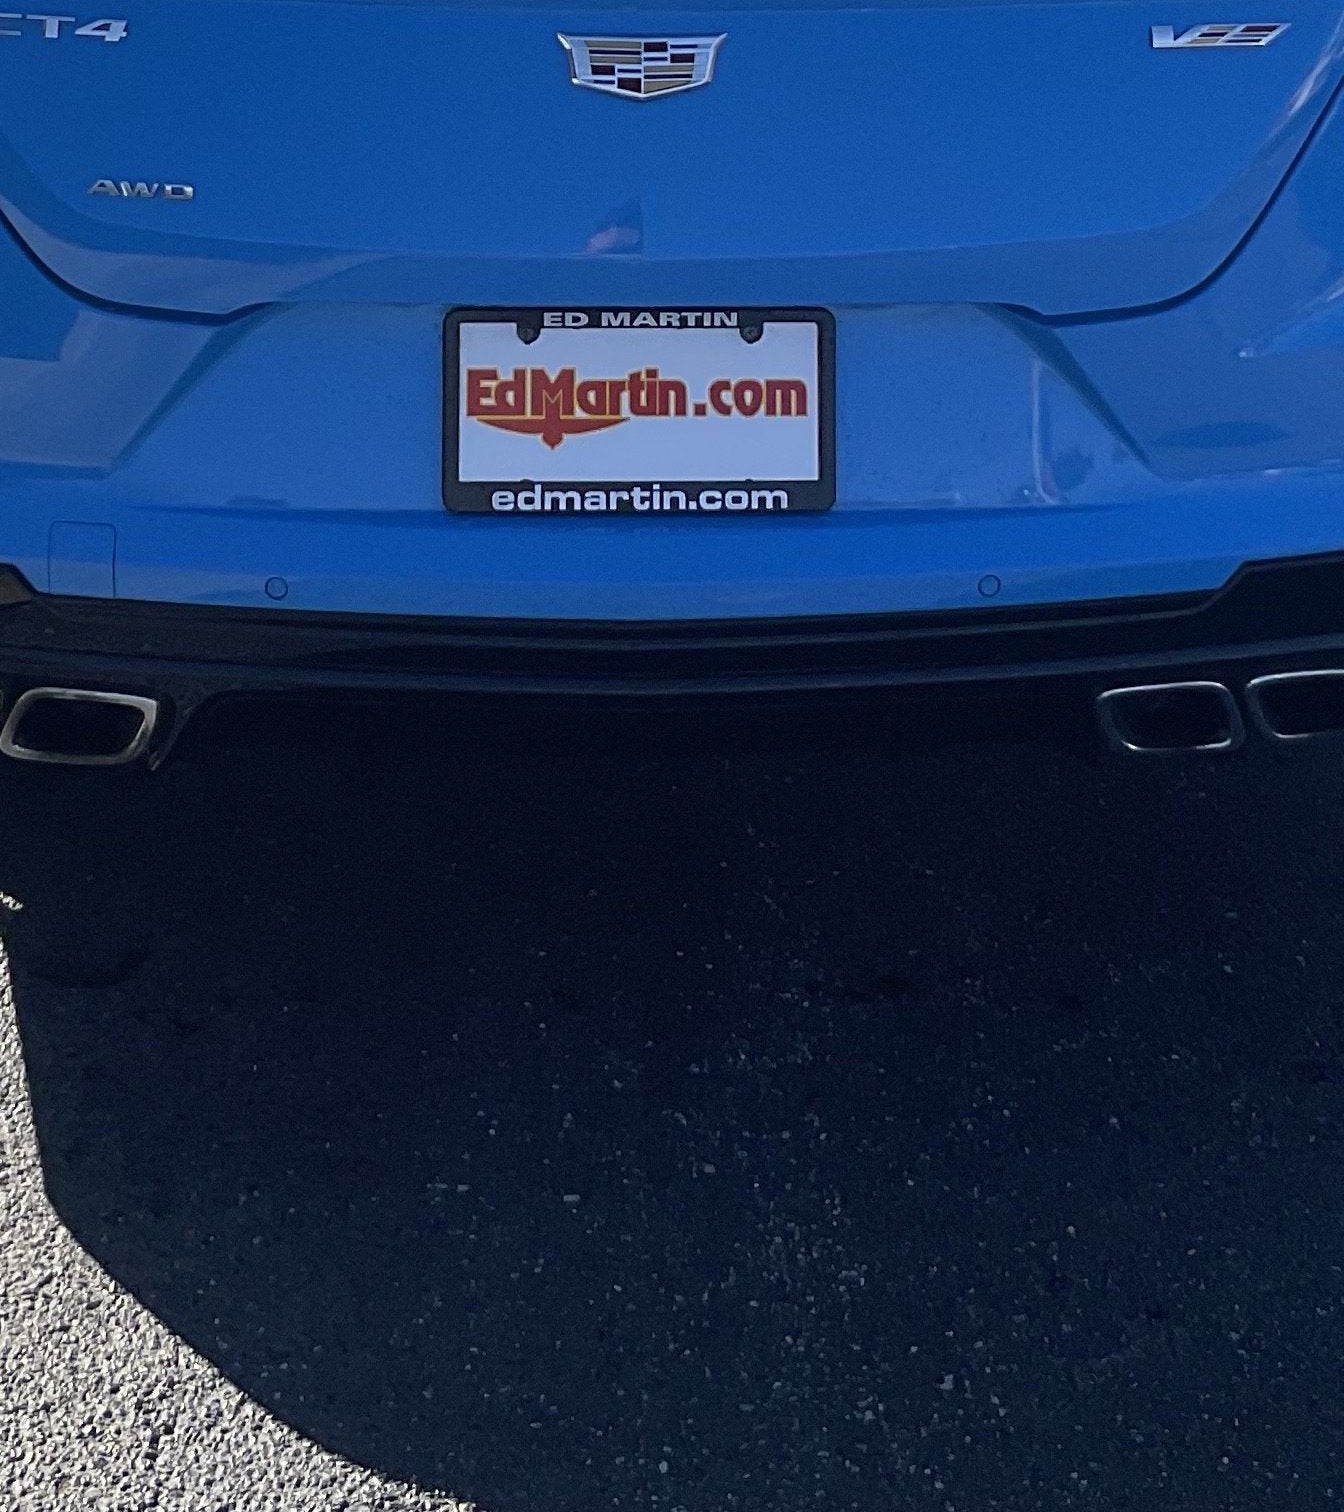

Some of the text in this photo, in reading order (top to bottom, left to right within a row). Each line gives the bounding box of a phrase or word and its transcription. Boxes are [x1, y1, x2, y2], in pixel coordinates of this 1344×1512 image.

[86, 178, 195, 201] AWD
[543, 311, 739, 327] ED MARTIN
[465, 366, 809, 418] EdMartin.com
[491, 483, 789, 512] edmartin.com
